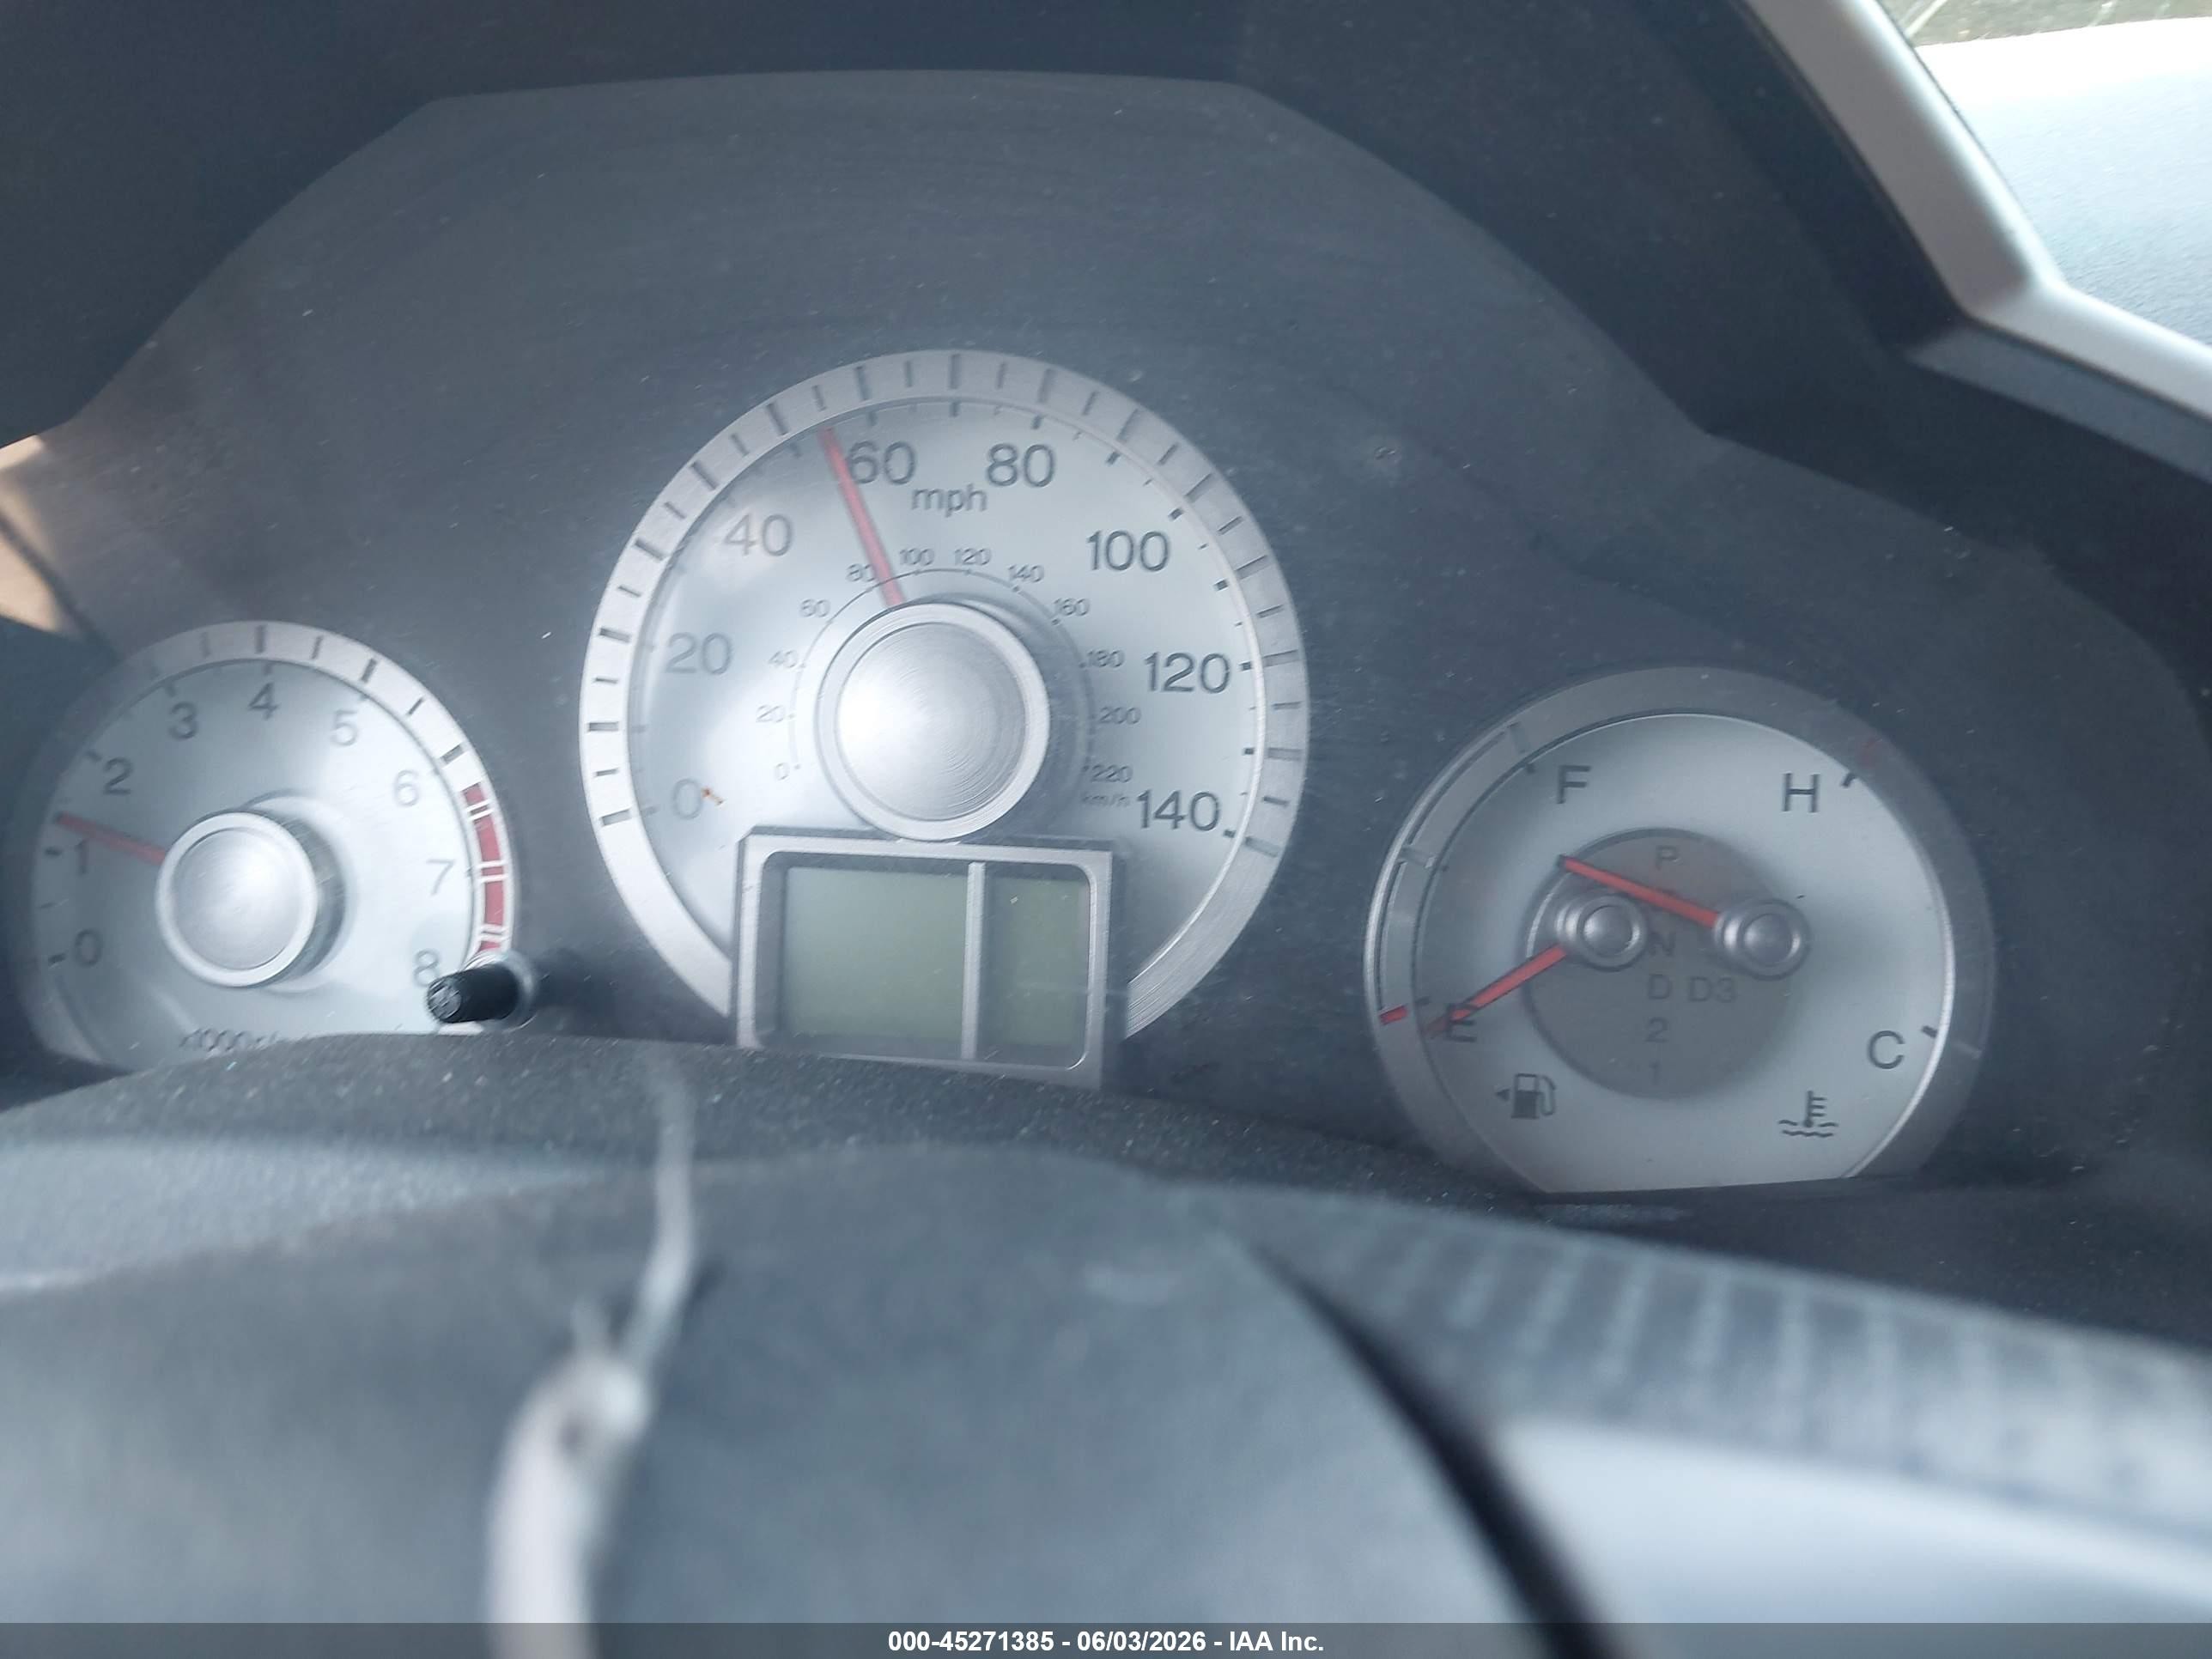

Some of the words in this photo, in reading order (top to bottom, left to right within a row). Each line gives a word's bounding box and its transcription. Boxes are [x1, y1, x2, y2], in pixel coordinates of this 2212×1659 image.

[848, 441, 916, 485] 60
[986, 443, 1056, 488] 80
[910, 483, 988, 517] mph
[724, 514, 793, 556] 40
[1086, 530, 1170, 573] 100
[899, 548, 935, 566] 100
[954, 548, 991, 566] 120
[1006, 564, 1045, 583] 140
[799, 599, 830, 618] 60
[1053, 598, 1091, 617] 160
[665, 633, 732, 675] 20
[768, 649, 799, 669] 40
[1143, 653, 1231, 695] 120
[248, 684, 277, 719] 4
[756, 705, 786, 723] 20
[1098, 707, 1142, 726] 200
[168, 702, 198, 739] 3
[331, 710, 357, 747] 5
[104, 757, 132, 795] 2
[392, 769, 419, 807] 6
[1091, 764, 1133, 783] 220
[1559, 764, 1591, 804] F
[672, 779, 702, 820] 0
[1136, 789, 1220, 832] 140
[1782, 772, 1819, 813] H
[74, 838, 90, 876] 1
[1655, 845, 1680, 871] P
[426, 859, 455, 896] 7
[75, 929, 101, 966] 0
[412, 951, 442, 988] 8
[1648, 974, 1673, 1000] D
[1687, 975, 1738, 1003] D3
[1445, 1002, 1476, 1043] E
[1645, 1017, 1668, 1043] 2
[1867, 1030, 1904, 1069] C
